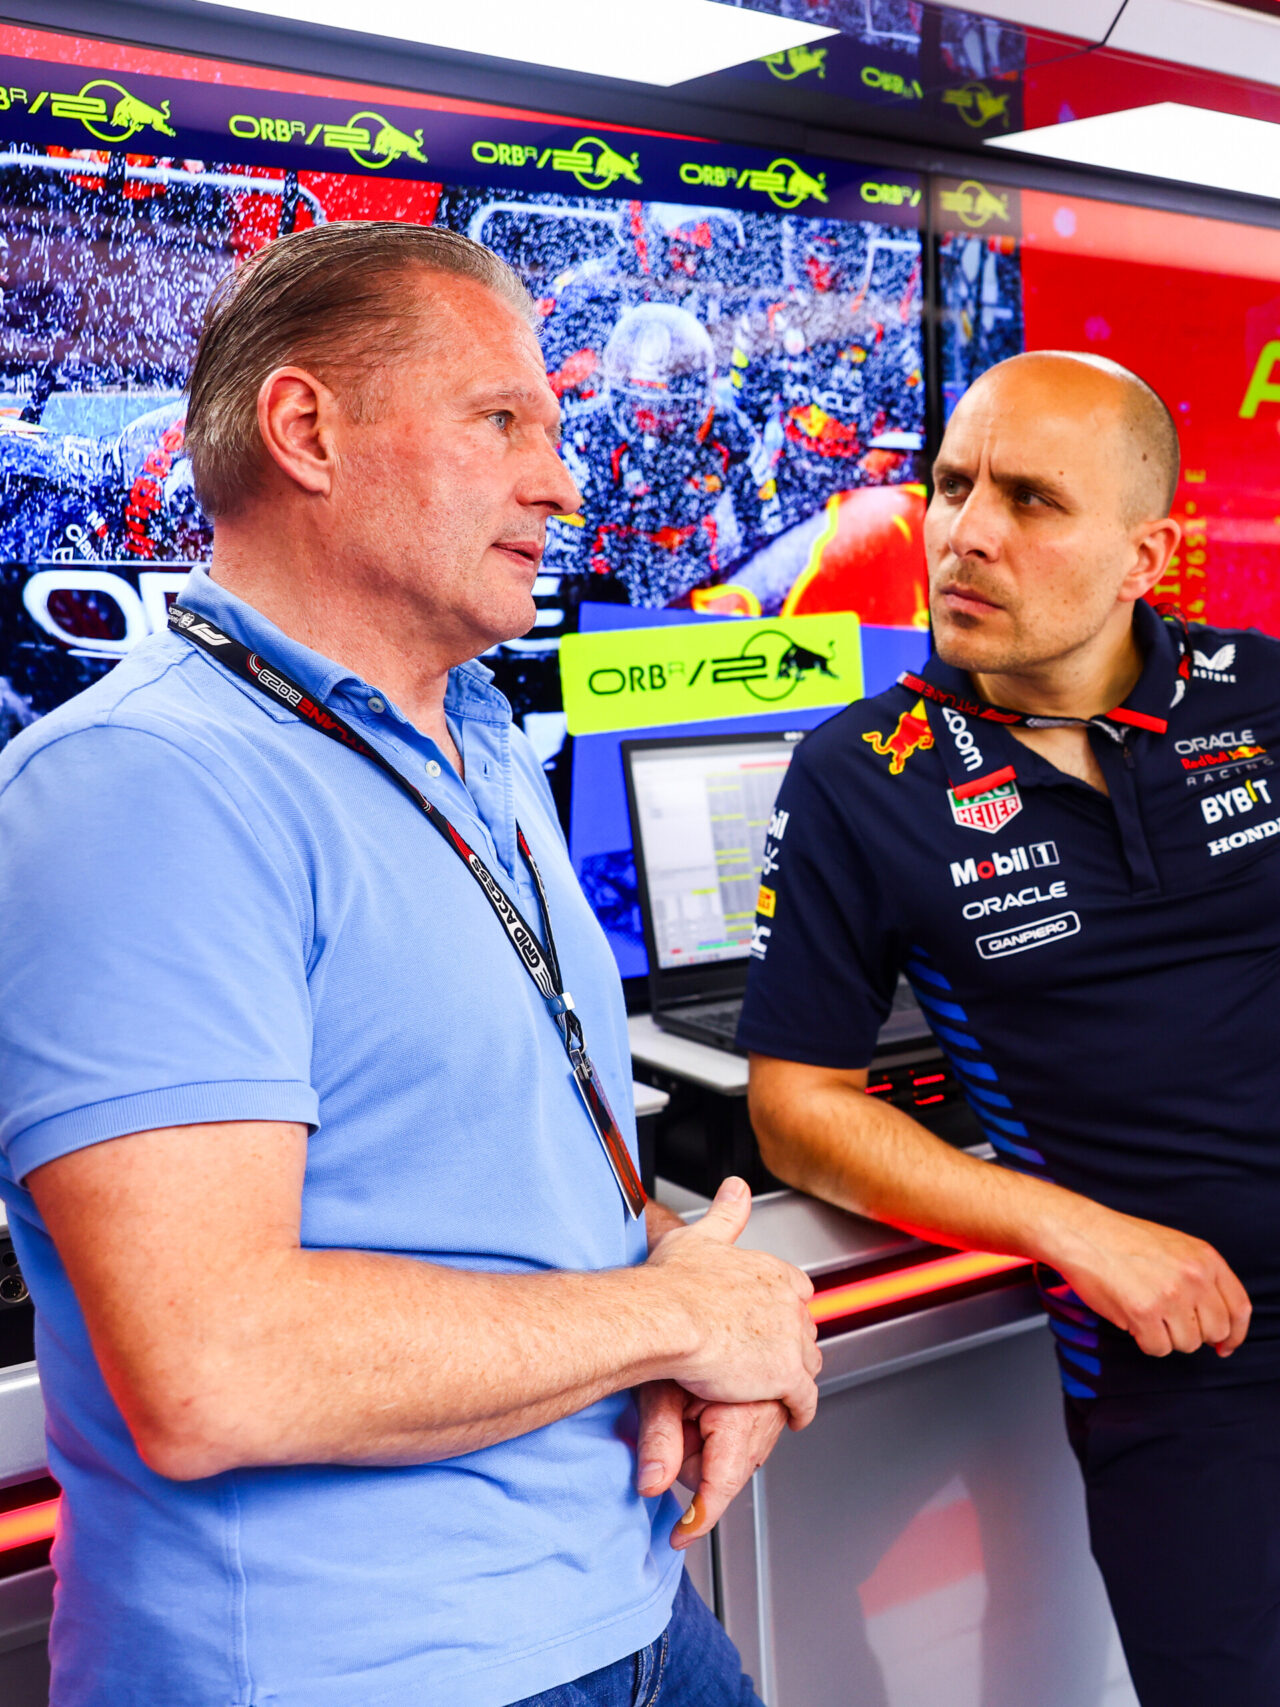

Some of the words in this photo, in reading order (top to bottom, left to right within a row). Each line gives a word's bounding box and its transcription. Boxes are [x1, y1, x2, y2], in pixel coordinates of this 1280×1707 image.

[257, 668, 303, 707] 2023
[1192, 667, 1237, 684] ASTORE
[942, 706, 984, 772] zoom
[1174, 728, 1257, 755] ORACLE
[957, 797, 1018, 829] HEUER
[1201, 778, 1273, 825] BYBIT
[949, 846, 1031, 888] Mobil
[470, 856, 520, 925] ACCESS
[961, 880, 1069, 921] ORACLE
[512, 928, 541, 969] GRID
[987, 919, 1068, 952] GIANPIERO
